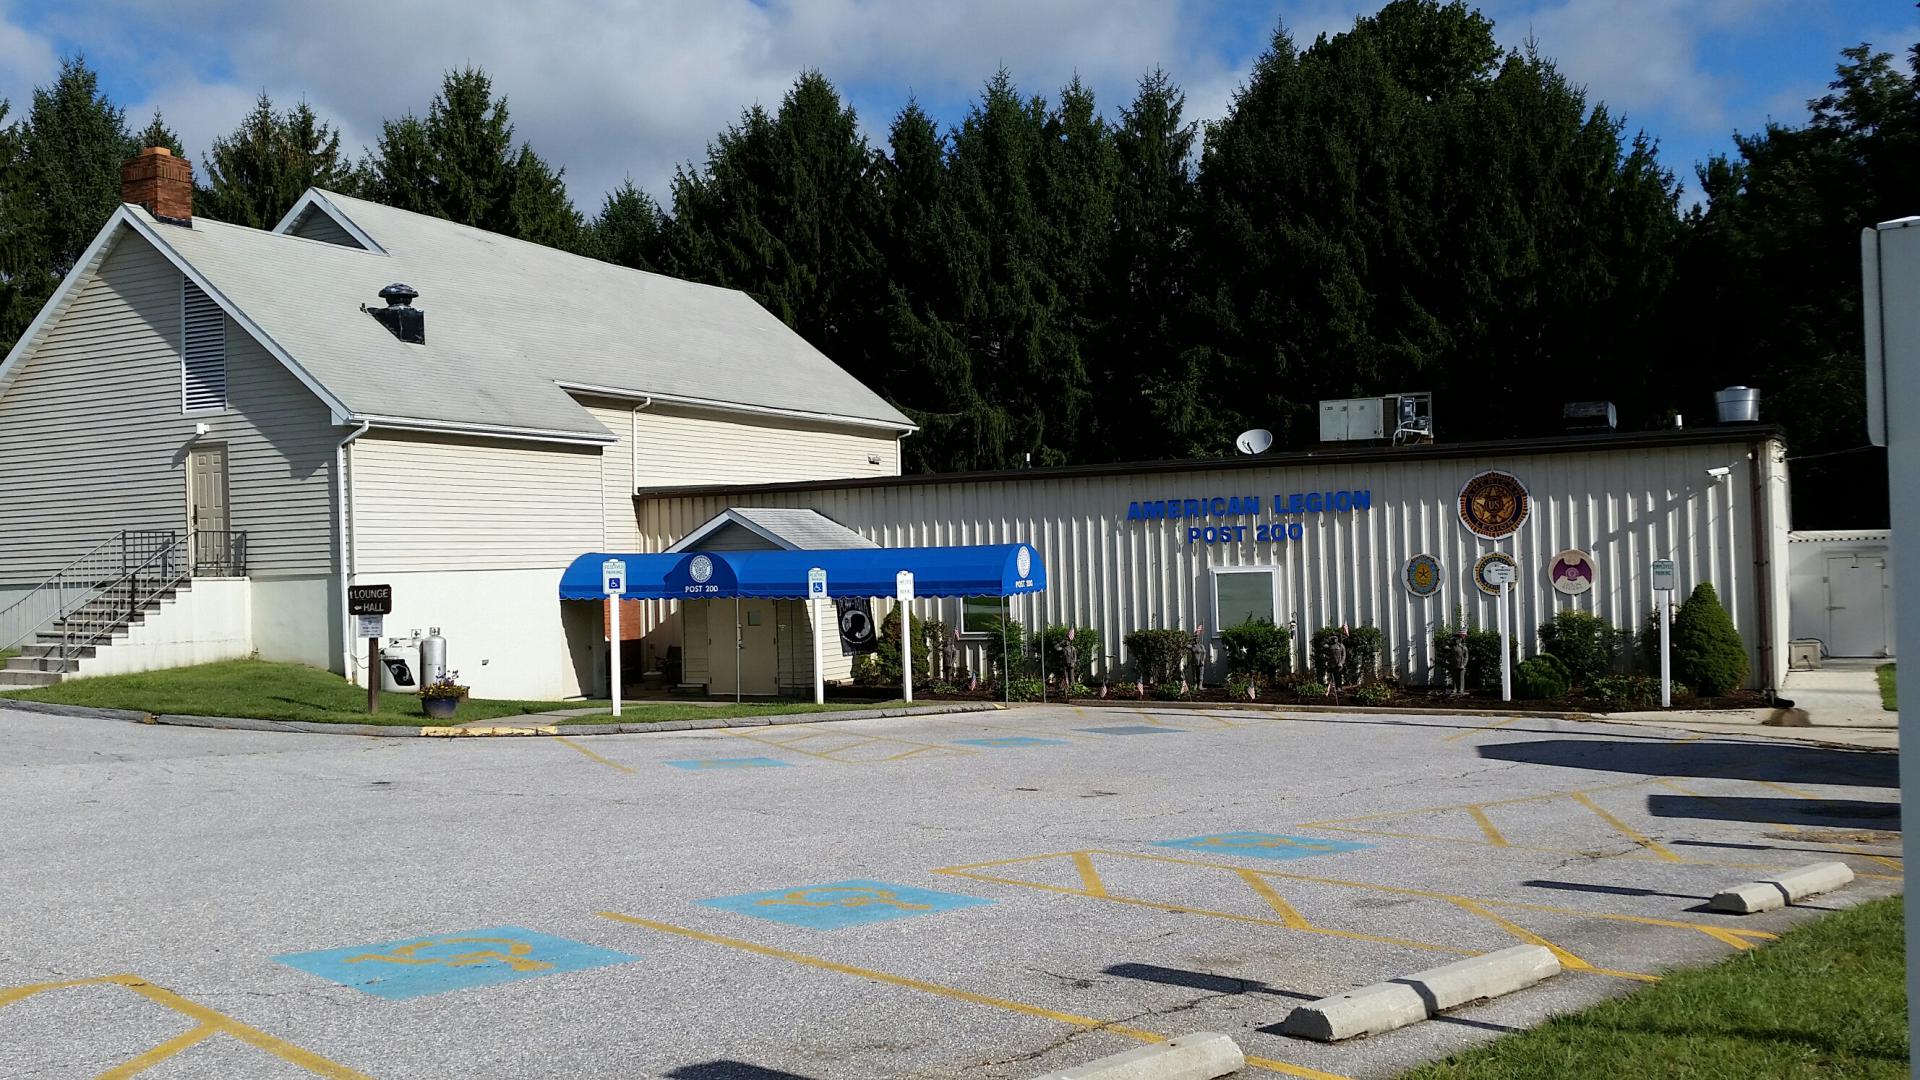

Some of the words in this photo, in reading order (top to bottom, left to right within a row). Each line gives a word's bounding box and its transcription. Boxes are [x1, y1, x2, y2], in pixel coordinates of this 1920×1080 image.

[1127, 496, 1260, 519] AMERICAN
[1274, 490, 1371, 514] LEGION
[1188, 526, 1247, 544] POST
[1257, 524, 1304, 543] 200
[354, 589, 389, 599] LOUNGE
[684, 585, 703, 593] POST
[705, 585, 719, 593] 200
[363, 603, 384, 611] HALL
